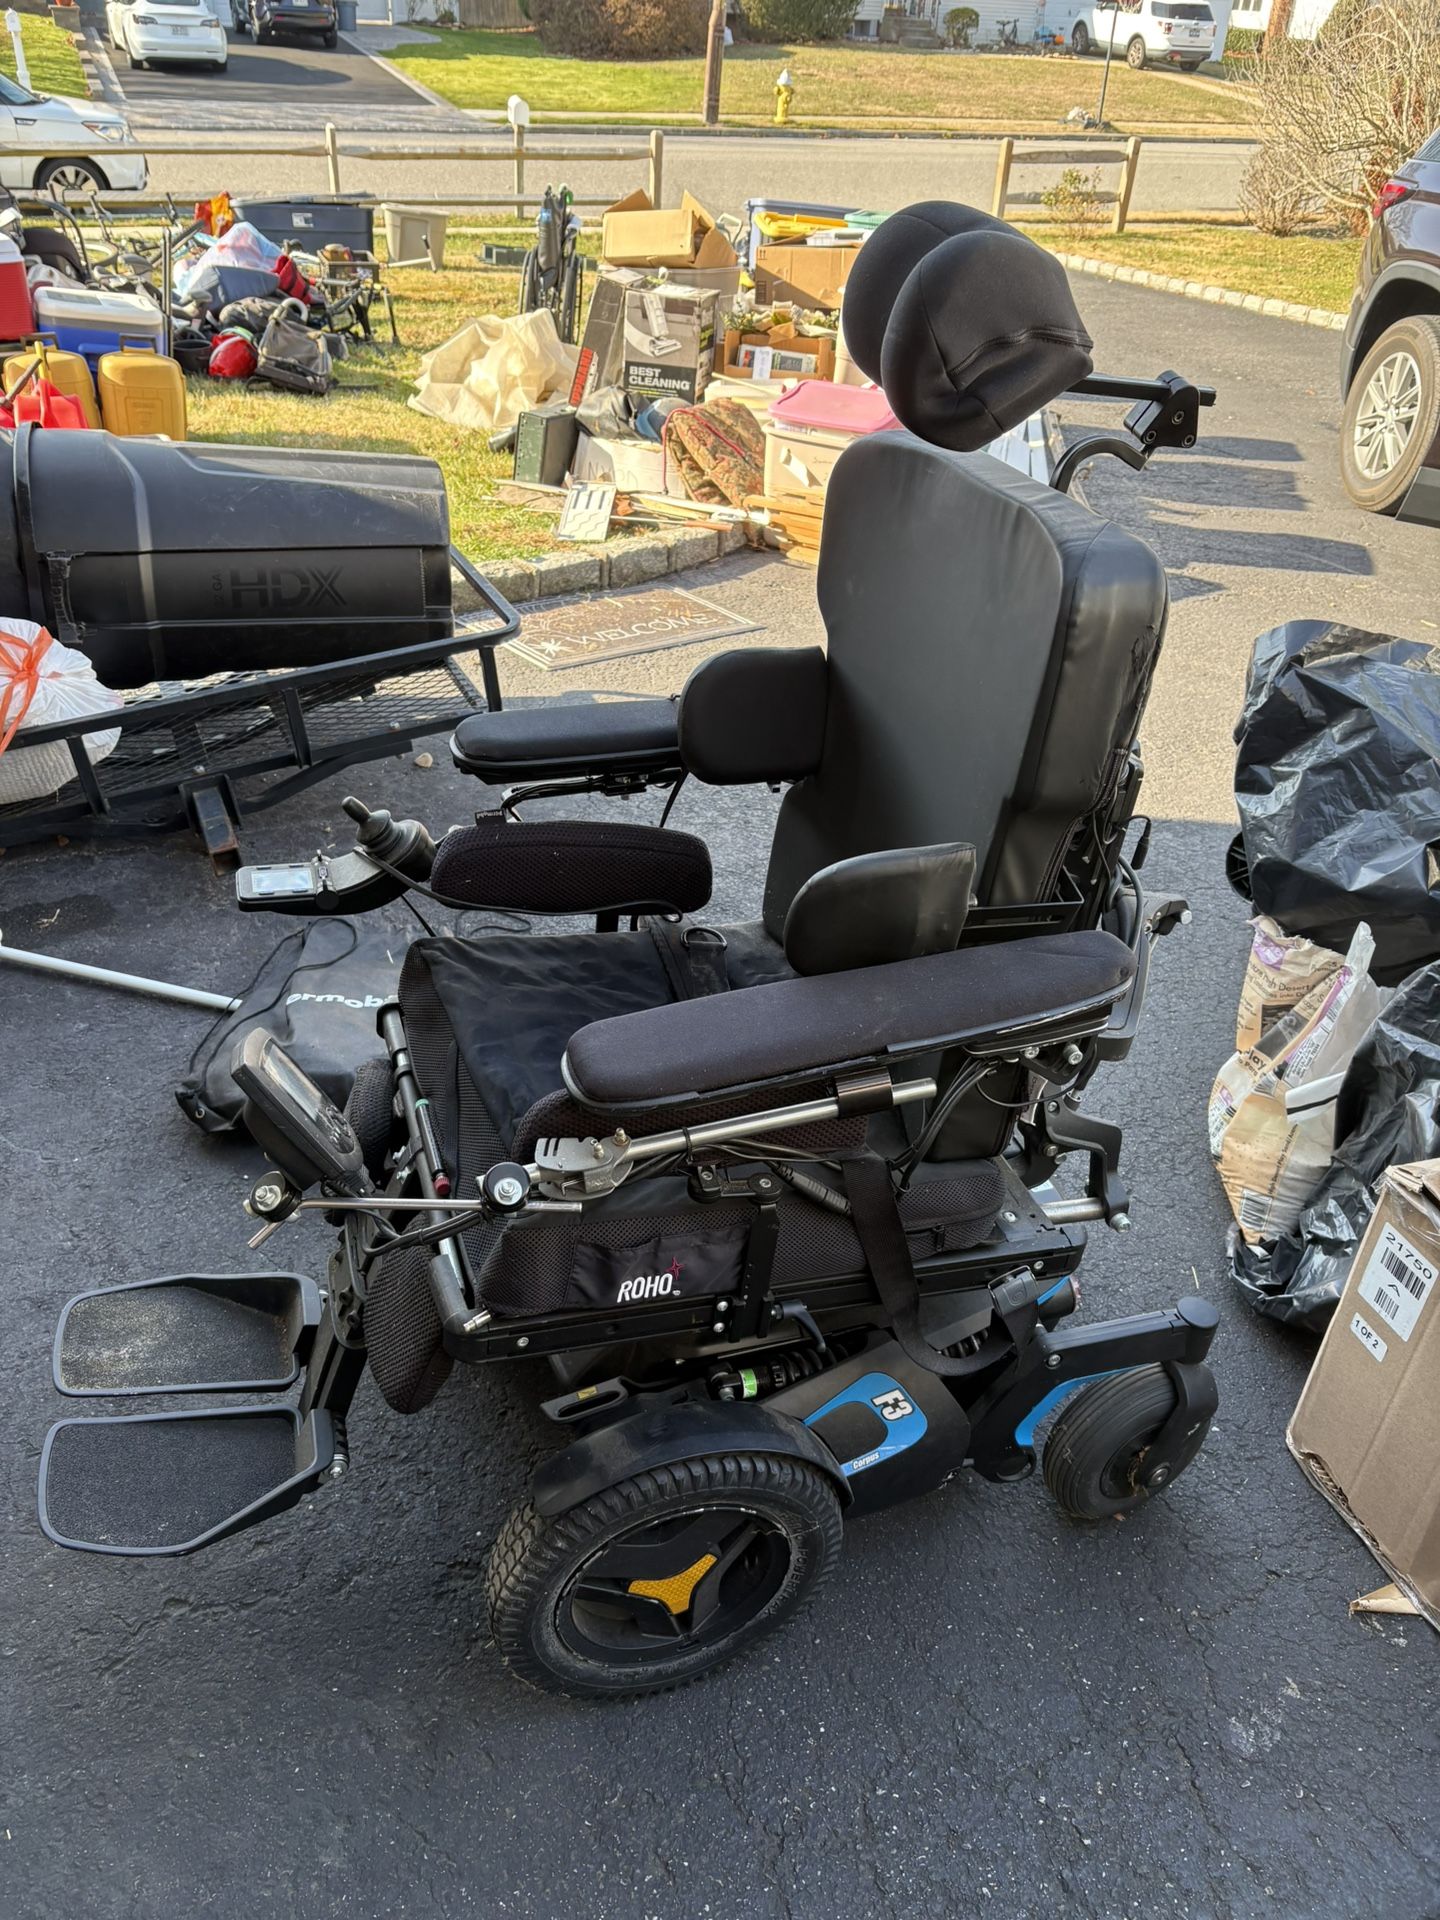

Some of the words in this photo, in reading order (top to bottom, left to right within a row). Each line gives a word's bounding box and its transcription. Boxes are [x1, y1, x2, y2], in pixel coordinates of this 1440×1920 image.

[629, 366, 661, 377] BEST
[629, 375, 690, 390] CLEANING
[230, 566, 347, 608] HDX
[566, 613, 715, 645] WELCOME
[1385, 1232, 1433, 1280] 21750
[617, 1273, 673, 1303] ROHO
[1388, 1284, 1401, 1298] A
[1355, 1319, 1360, 1328] 1
[1360, 1327, 1373, 1341] OF
[1372, 1338, 1379, 1349] 2
[871, 1388, 914, 1422] F3
[852, 1451, 880, 1470] Corpus
